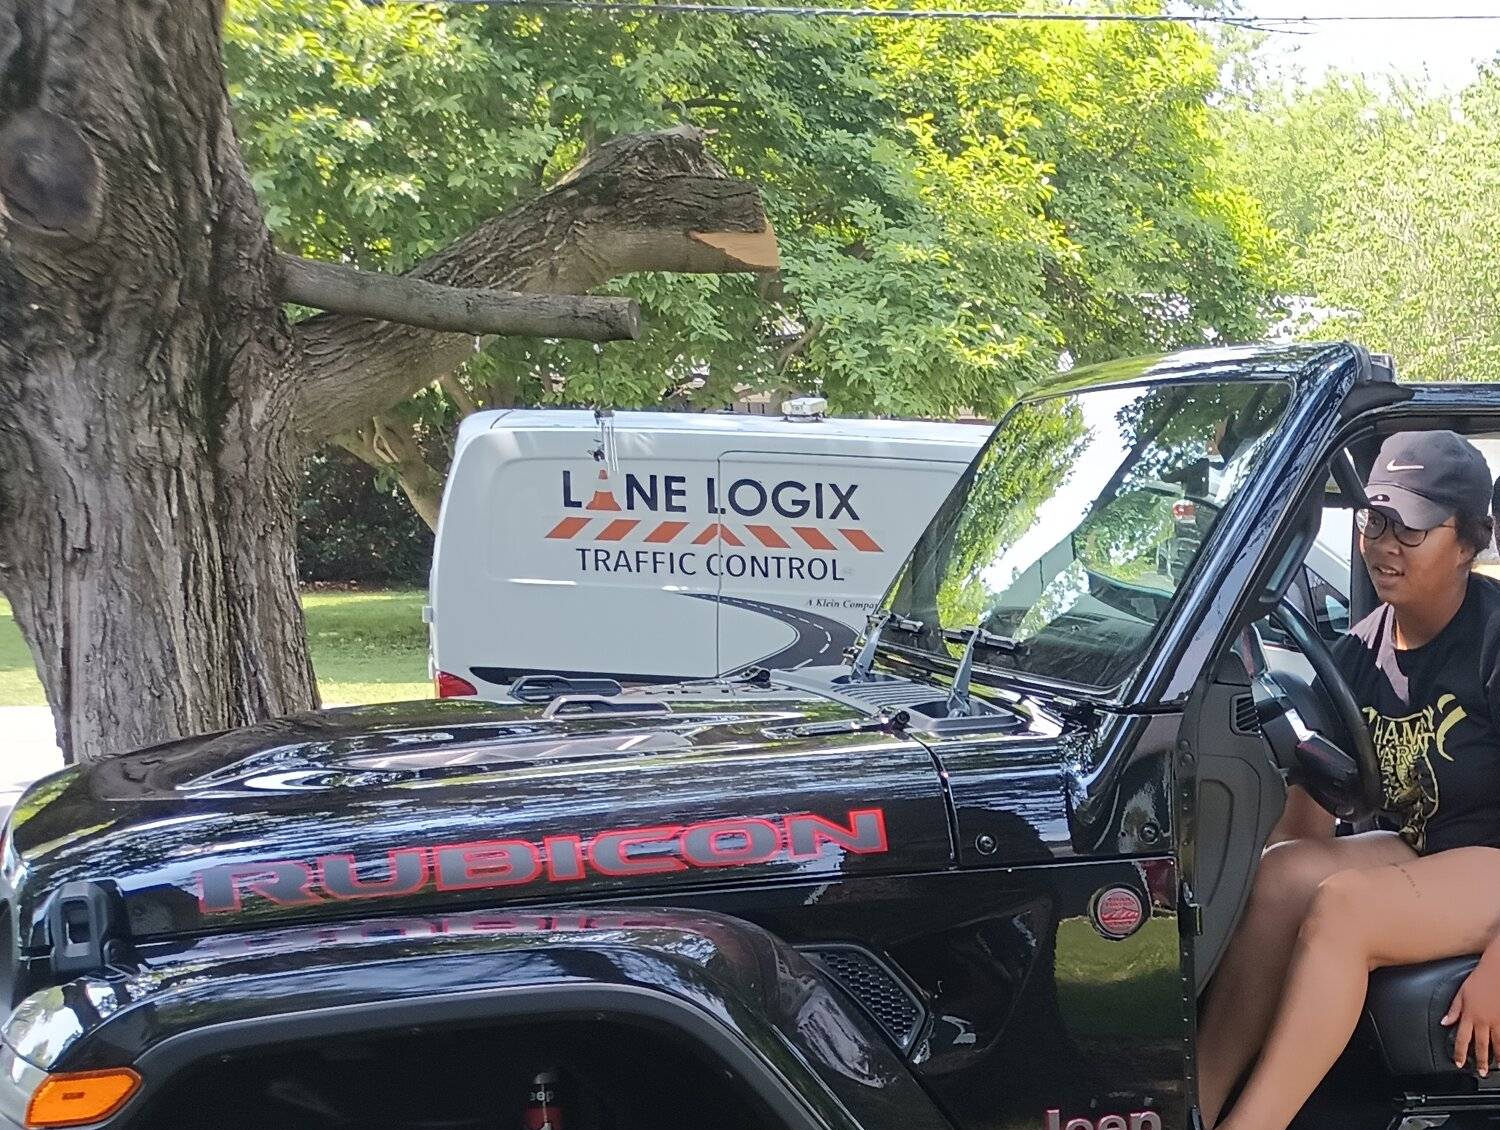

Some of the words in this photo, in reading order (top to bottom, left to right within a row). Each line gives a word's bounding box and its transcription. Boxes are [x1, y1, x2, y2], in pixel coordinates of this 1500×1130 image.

[706, 477, 860, 521] LOGIX
[576, 547, 697, 576] TRAFFIC
[705, 554, 845, 582] CONTROL
[816, 598, 840, 608] Klein
[199, 808, 889, 914] RUBICON
